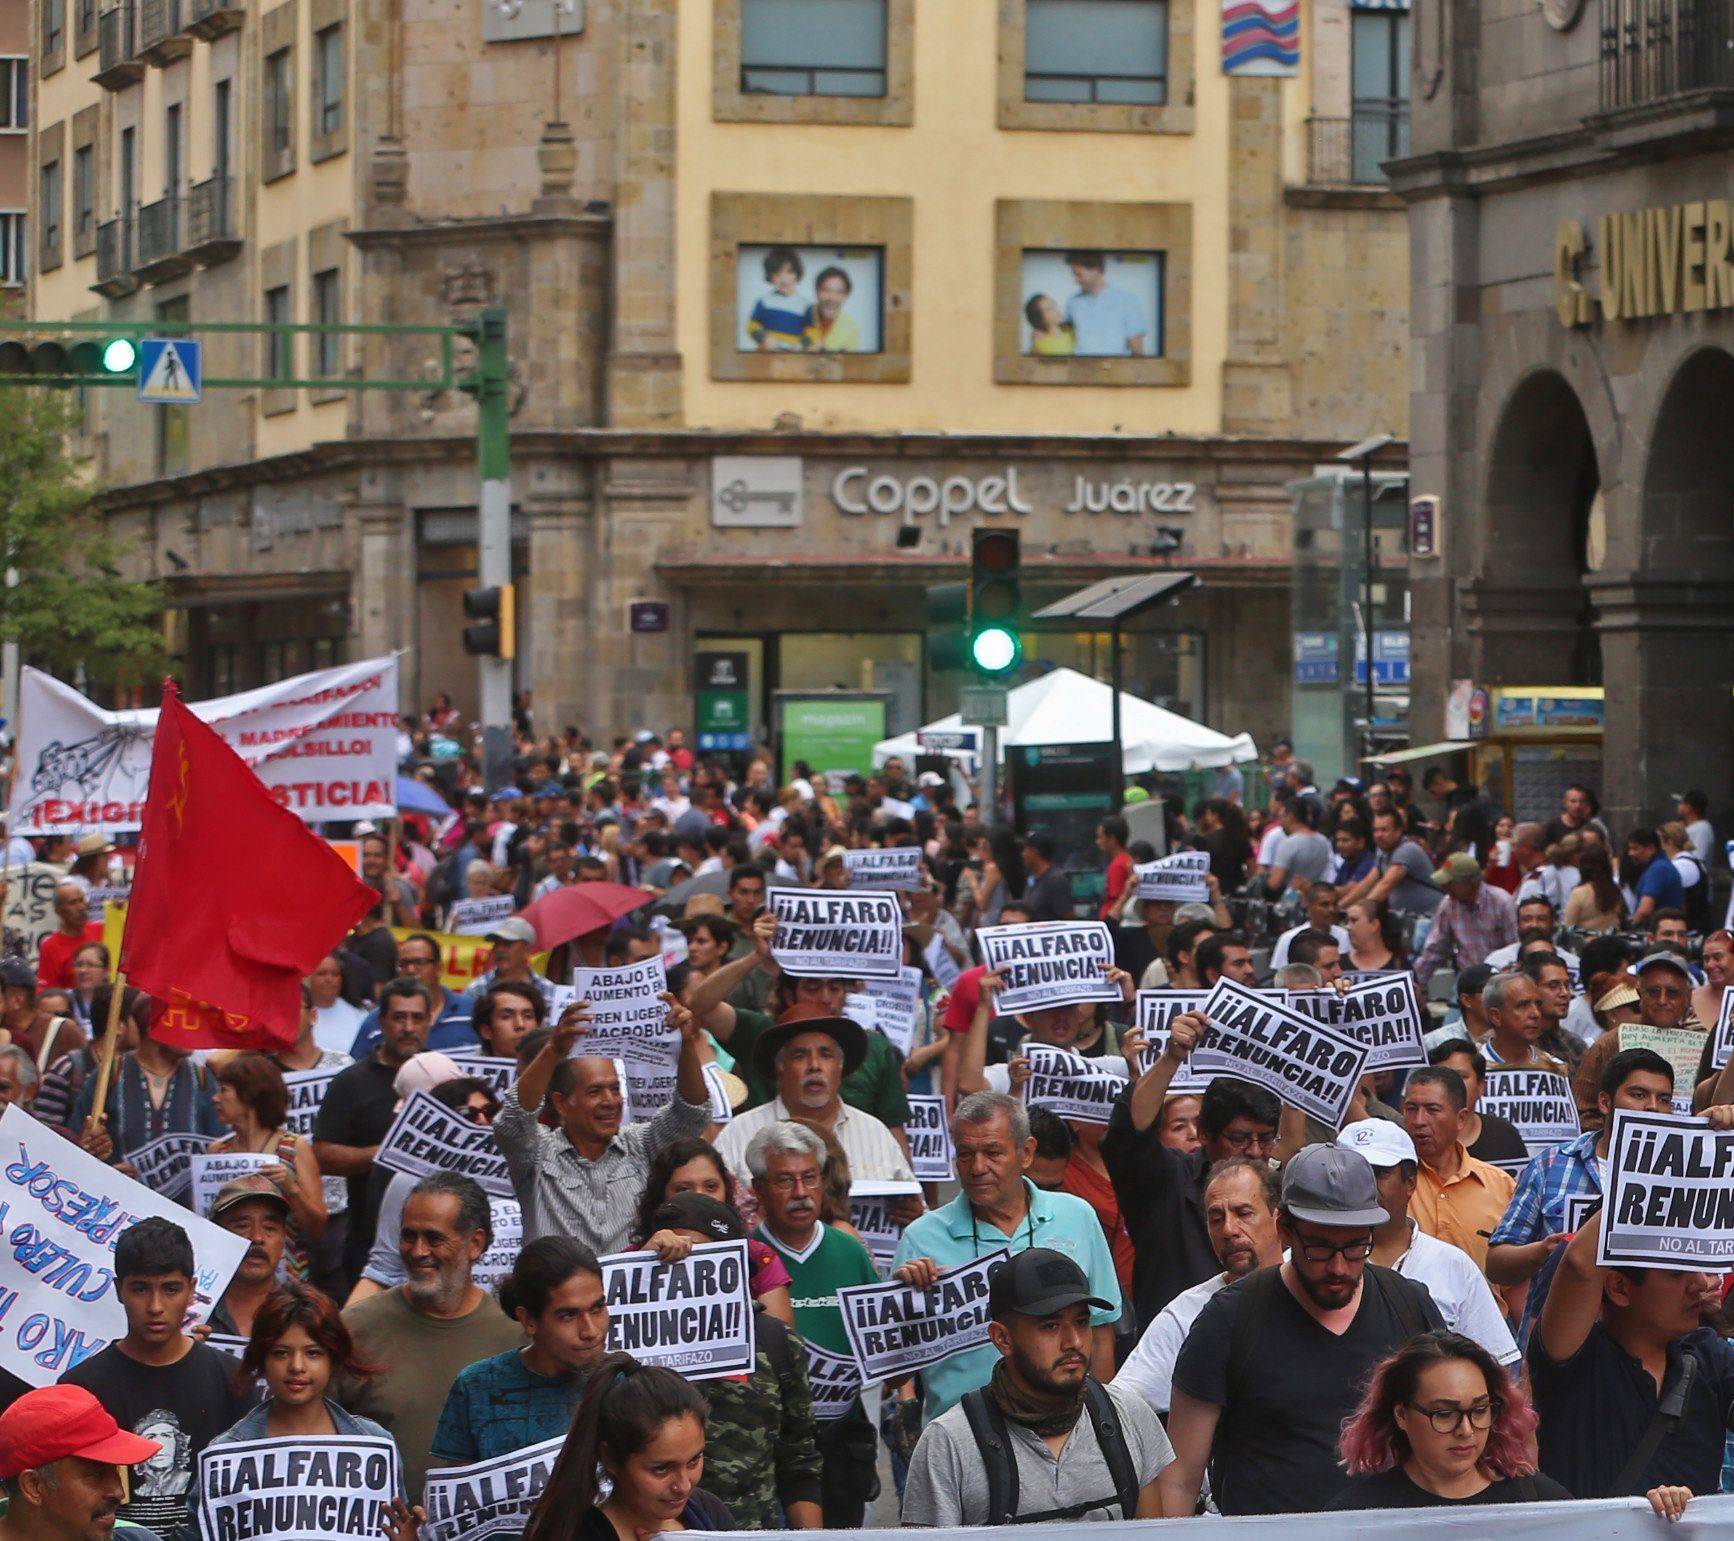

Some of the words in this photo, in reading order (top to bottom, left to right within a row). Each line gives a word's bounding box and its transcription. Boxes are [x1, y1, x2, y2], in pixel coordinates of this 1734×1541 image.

[831, 465, 1033, 526] Coppel
[1065, 475, 1196, 514] Juárez
[270, 778, 392, 808] STICIA!
[776, 898, 893, 925] ¡¡ALFARO
[772, 926, 893, 955] RENUNCIA!!
[994, 932, 1104, 962] ¡¡ALFARO
[584, 984, 651, 1002] AUMENTO
[592, 969, 645, 988] ABAJO
[647, 965, 661, 979] EL
[1294, 986, 1406, 1025] ALFARO
[1211, 994, 1358, 1079] ¡¡ALFARO
[1348, 1016, 1412, 1047] NCIA!!
[1198, 1026, 1344, 1105] RENUNCIA!!
[1031, 1075, 1123, 1104] RENUNC
[407, 1104, 505, 1158] ¡¡ALFA
[394, 1130, 511, 1180] RENUNCIA
[1659, 1236, 1681, 1251] NO
[1684, 1239, 1705, 1254] AL
[606, 1256, 740, 1307] ALFARO
[16, 1312, 107, 1371] ARO
[605, 1301, 742, 1351] ENUNCIA!!
[660, 1350, 714, 1367] TARIFAZO
[209, 1450, 389, 1500] ¡¡ALFARO
[428, 1460, 553, 1524] ¡¡ALFA
[215, 1494, 386, 1541] RENUNCIA!!
